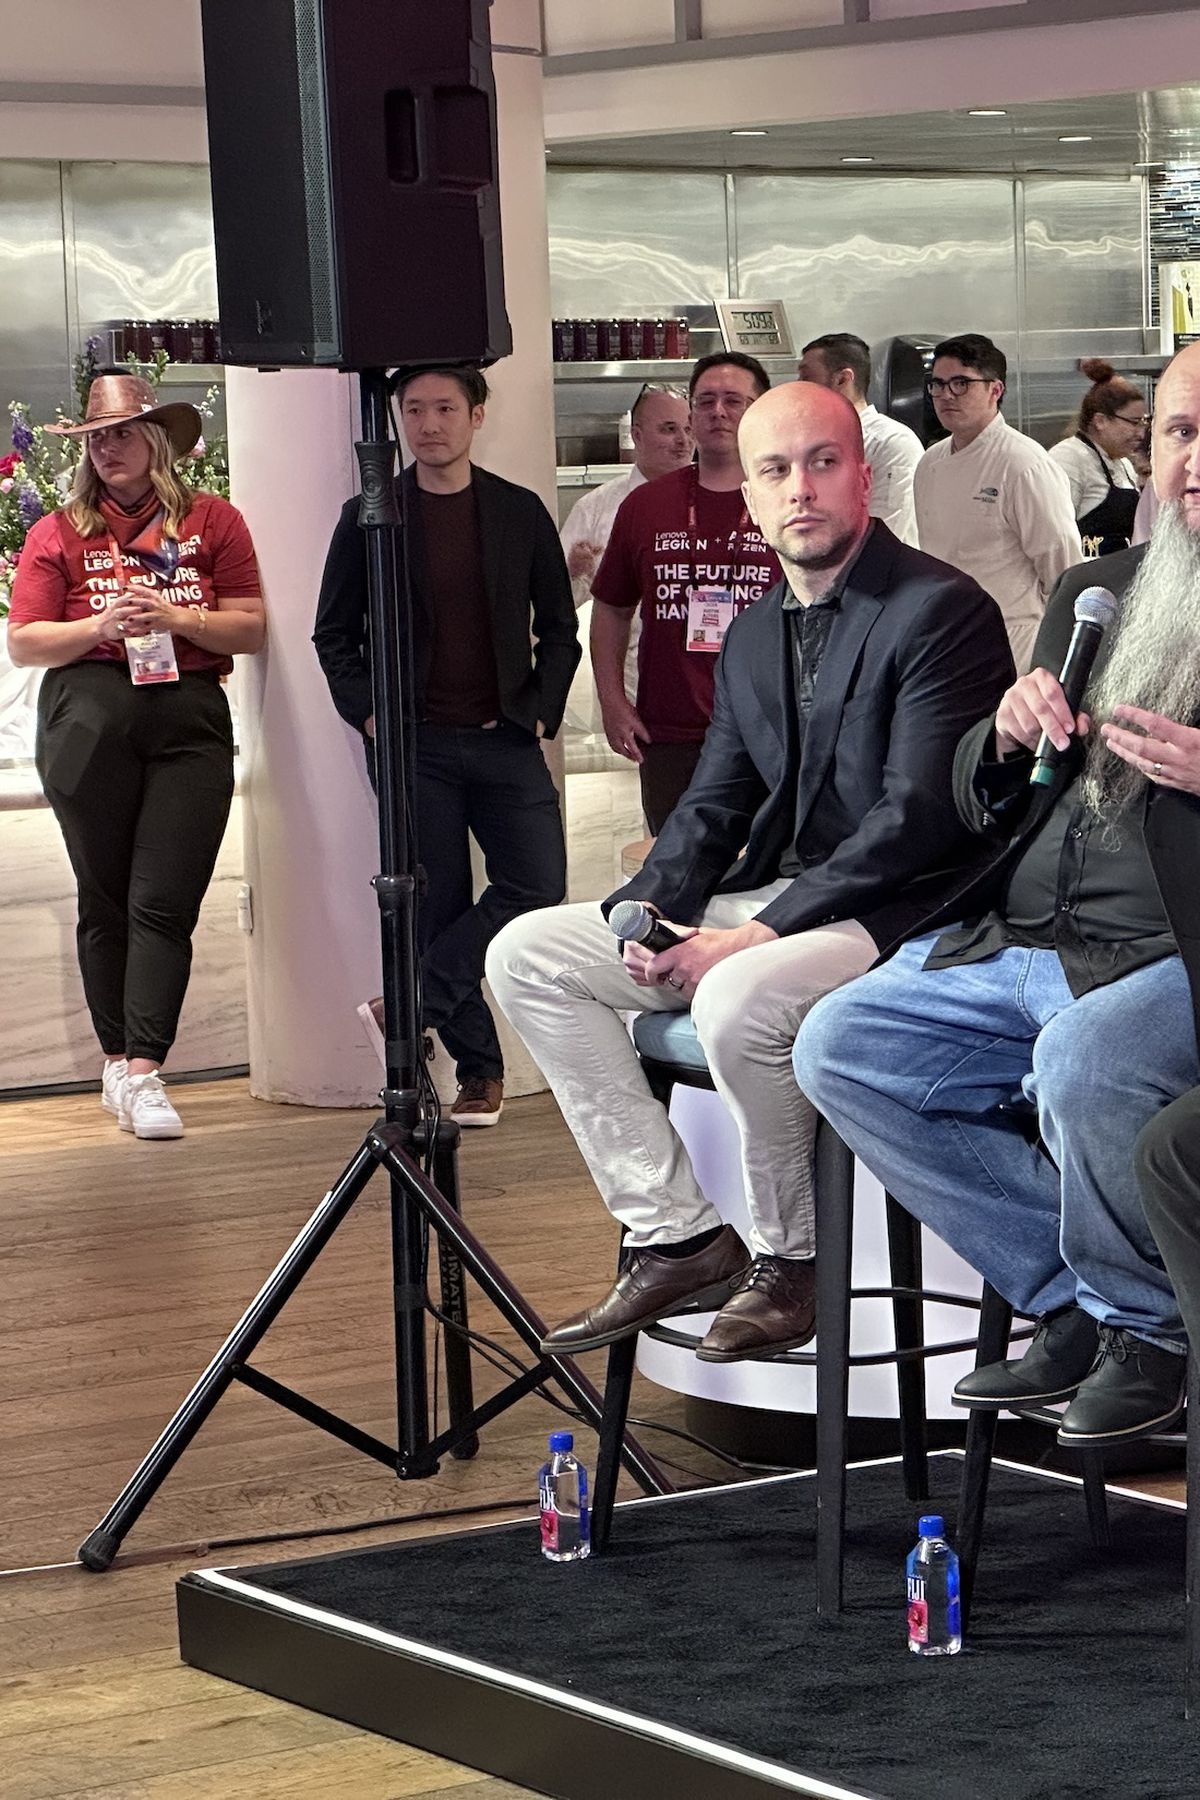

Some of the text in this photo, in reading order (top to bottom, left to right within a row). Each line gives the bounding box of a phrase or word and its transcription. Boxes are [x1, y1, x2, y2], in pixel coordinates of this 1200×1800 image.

[655, 532, 687, 541] Lenovo
[728, 543, 767, 552] RZEN
[84, 555, 140, 571] LEGON
[654, 564, 771, 582] THE FUTURE
[158, 585, 202, 603] MING
[656, 584, 681, 599] OF
